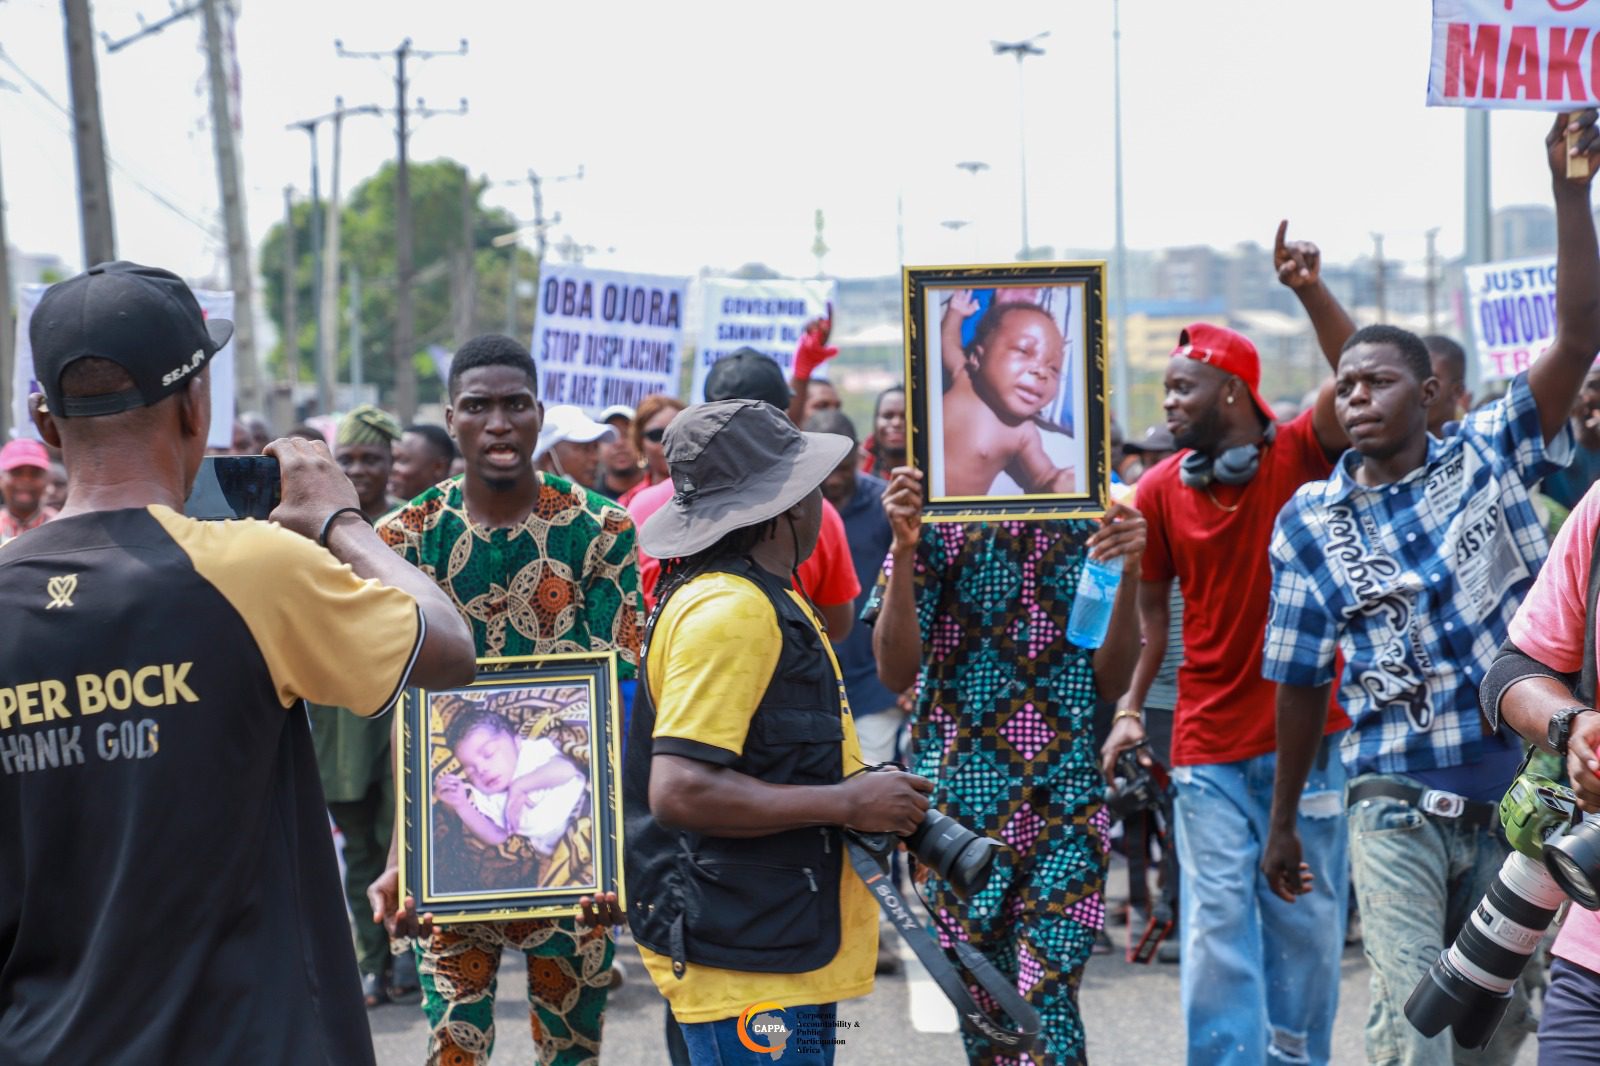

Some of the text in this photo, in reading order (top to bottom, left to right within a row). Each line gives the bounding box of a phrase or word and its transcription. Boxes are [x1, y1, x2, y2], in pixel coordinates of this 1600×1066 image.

[1444, 23, 1600, 101] MAK
[543, 275, 681, 328] OBA OJORA
[541, 328, 580, 361] STOP
[584, 334, 673, 374] DISPLACING
[543, 371, 566, 402] WE
[571, 375, 597, 405] ARE
[0, 662, 200, 730] PER BOCK
[875, 884, 918, 930] SONY
